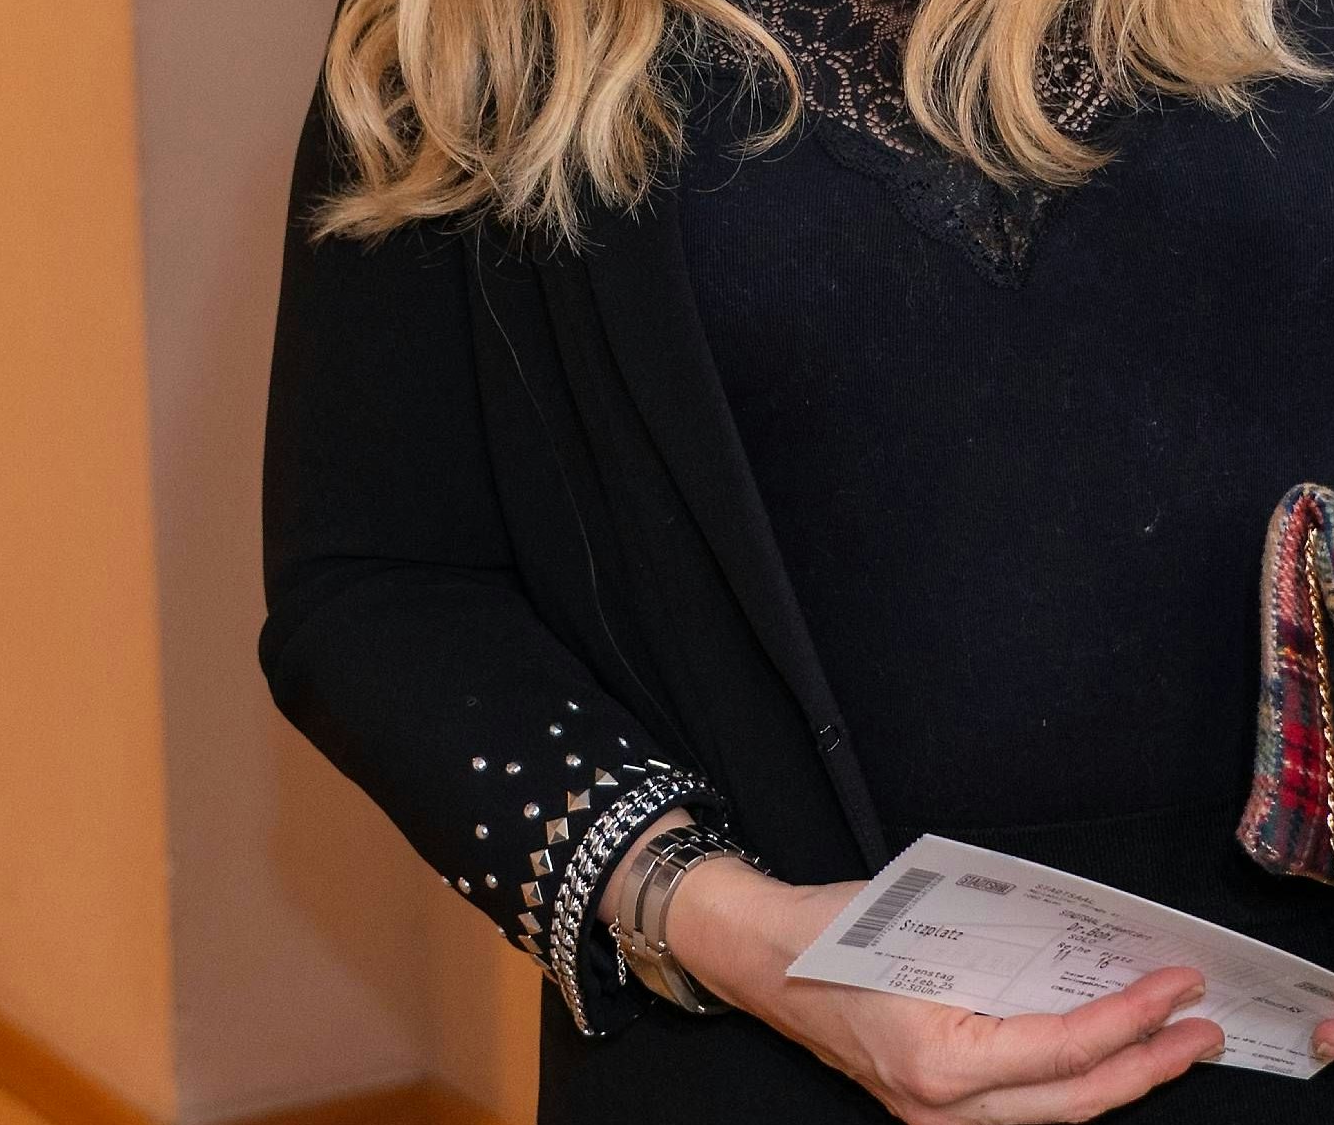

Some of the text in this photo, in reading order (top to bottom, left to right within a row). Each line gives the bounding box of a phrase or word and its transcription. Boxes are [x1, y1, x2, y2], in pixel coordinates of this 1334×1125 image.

[899, 919, 964, 942] Sitzplatz
[894, 973, 954, 990] 11.Feb.25
[900, 964, 955, 982] Dienstag
[888, 979, 942, 996] 19:30Uhr
